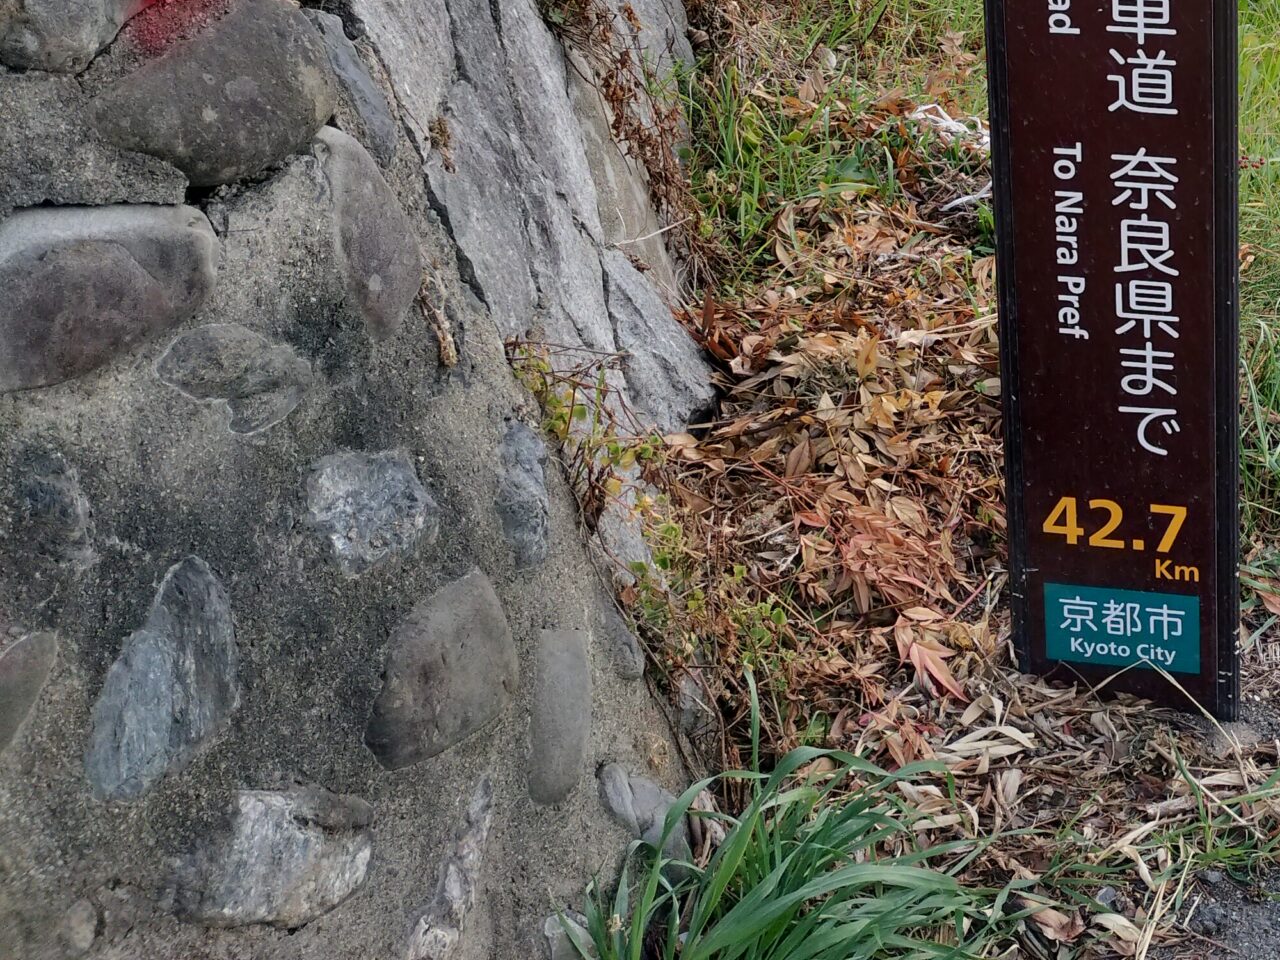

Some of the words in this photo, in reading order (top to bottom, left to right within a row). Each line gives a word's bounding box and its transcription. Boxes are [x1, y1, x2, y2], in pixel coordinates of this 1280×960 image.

[1052, 141, 1083, 181] To
[1054, 190, 1085, 266] Nara
[1057, 275, 1090, 341] Pref
[1109, 146, 1182, 457] 奈良県まで
[1042, 496, 1188, 554] 42.7
[1155, 558, 1200, 583] Km
[1058, 595, 1186, 641] 京都市
[1070, 637, 1131, 658] Kyoto
[1136, 644, 1177, 666] City
